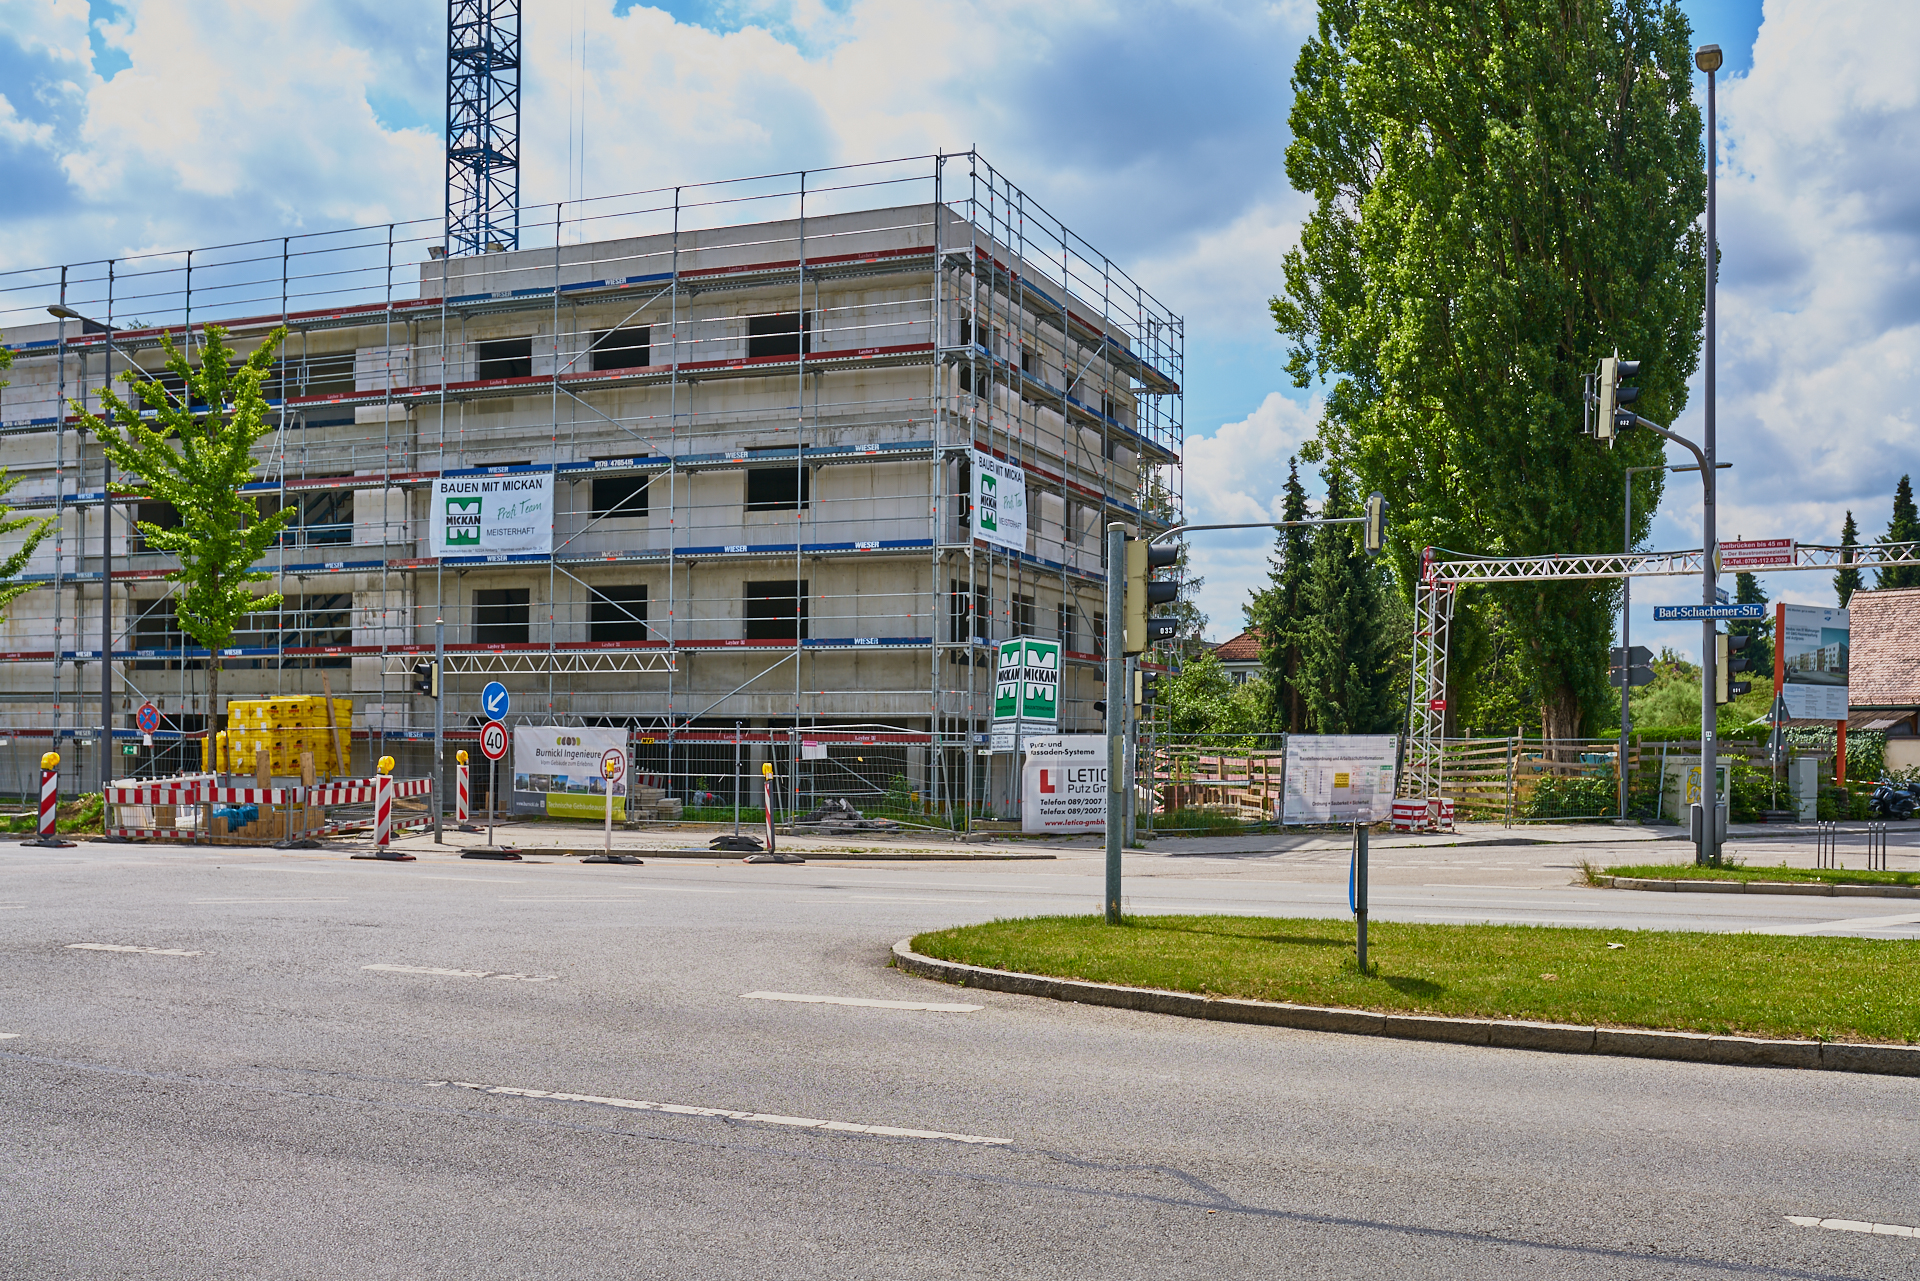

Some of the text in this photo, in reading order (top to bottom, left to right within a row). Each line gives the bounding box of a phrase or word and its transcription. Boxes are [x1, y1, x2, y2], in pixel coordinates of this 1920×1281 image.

[440, 479, 543, 493] BAUEN MIT MICKAN
[497, 498, 542, 521] Profi Team
[446, 515, 481, 526] MICKAN
[486, 527, 536, 537] MEISTERHAFT
[1659, 606, 1760, 618] Bad-Schachener-Str.
[998, 667, 1020, 683] MICKAN
[1024, 667, 1058, 683] MICKAN
[486, 732, 503, 749] 40
[1048, 740, 1062, 748] und
[536, 748, 602, 761] Burnickl Ingenieure
[1030, 749, 1095, 757] assaden-Systeme
[1067, 784, 1091, 793] Putz
[548, 801, 573, 810] Technische
[1067, 798, 1102, 806] 089/2007
[1067, 807, 1102, 815] 089/2007
